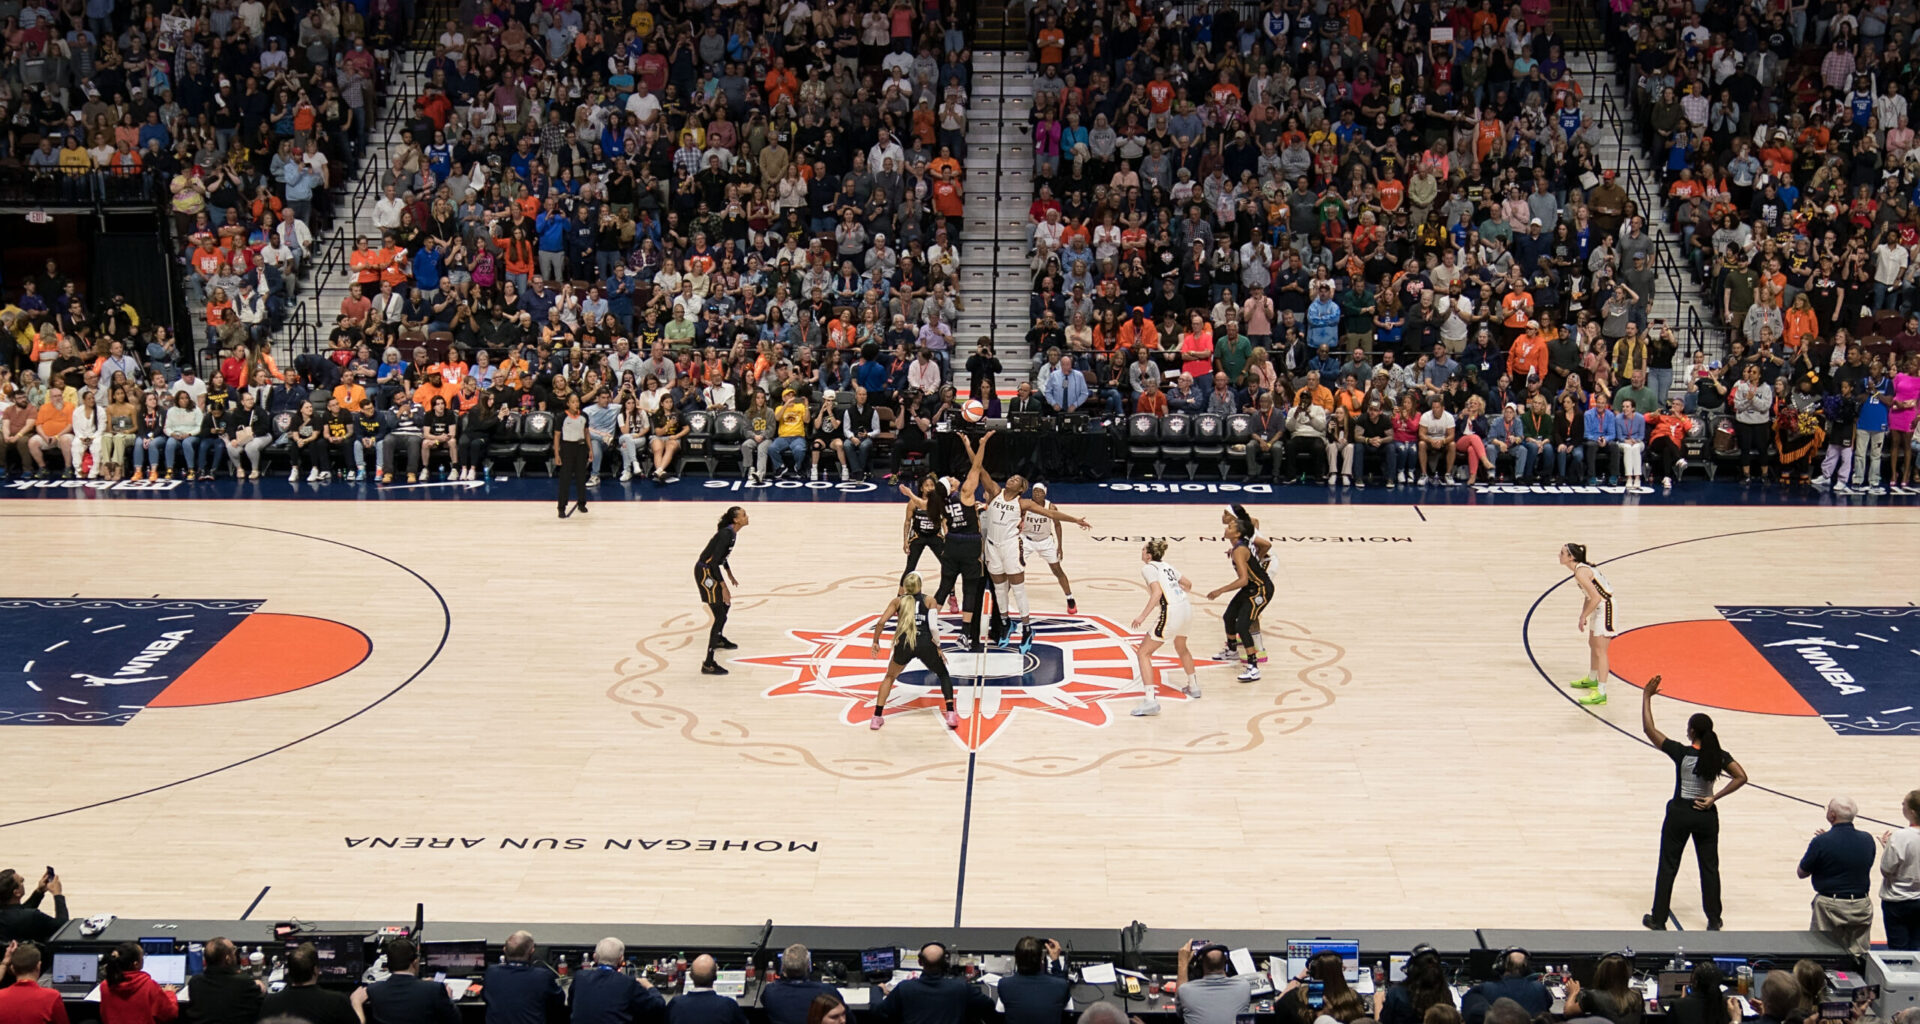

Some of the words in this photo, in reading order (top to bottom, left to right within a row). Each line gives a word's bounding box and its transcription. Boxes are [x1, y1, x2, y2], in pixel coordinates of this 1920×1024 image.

[1425, 237, 1437, 246] 22
[753, 419, 767, 431] 22
[4, 480, 117, 490] bank
[703, 479, 878, 493] Google
[945, 503, 964, 517] 42
[992, 501, 1016, 512] FEVER
[999, 511, 1006, 521] 7
[1026, 516, 1048, 524] FEVER
[1032, 524, 1041, 532] 17
[113, 629, 195, 677] WNBA
[1796, 646, 1867, 696] WNBA
[344, 837, 486, 849] ARENA
[500, 837, 587, 850] SUN
[605, 837, 818, 853] MOHEGAN
